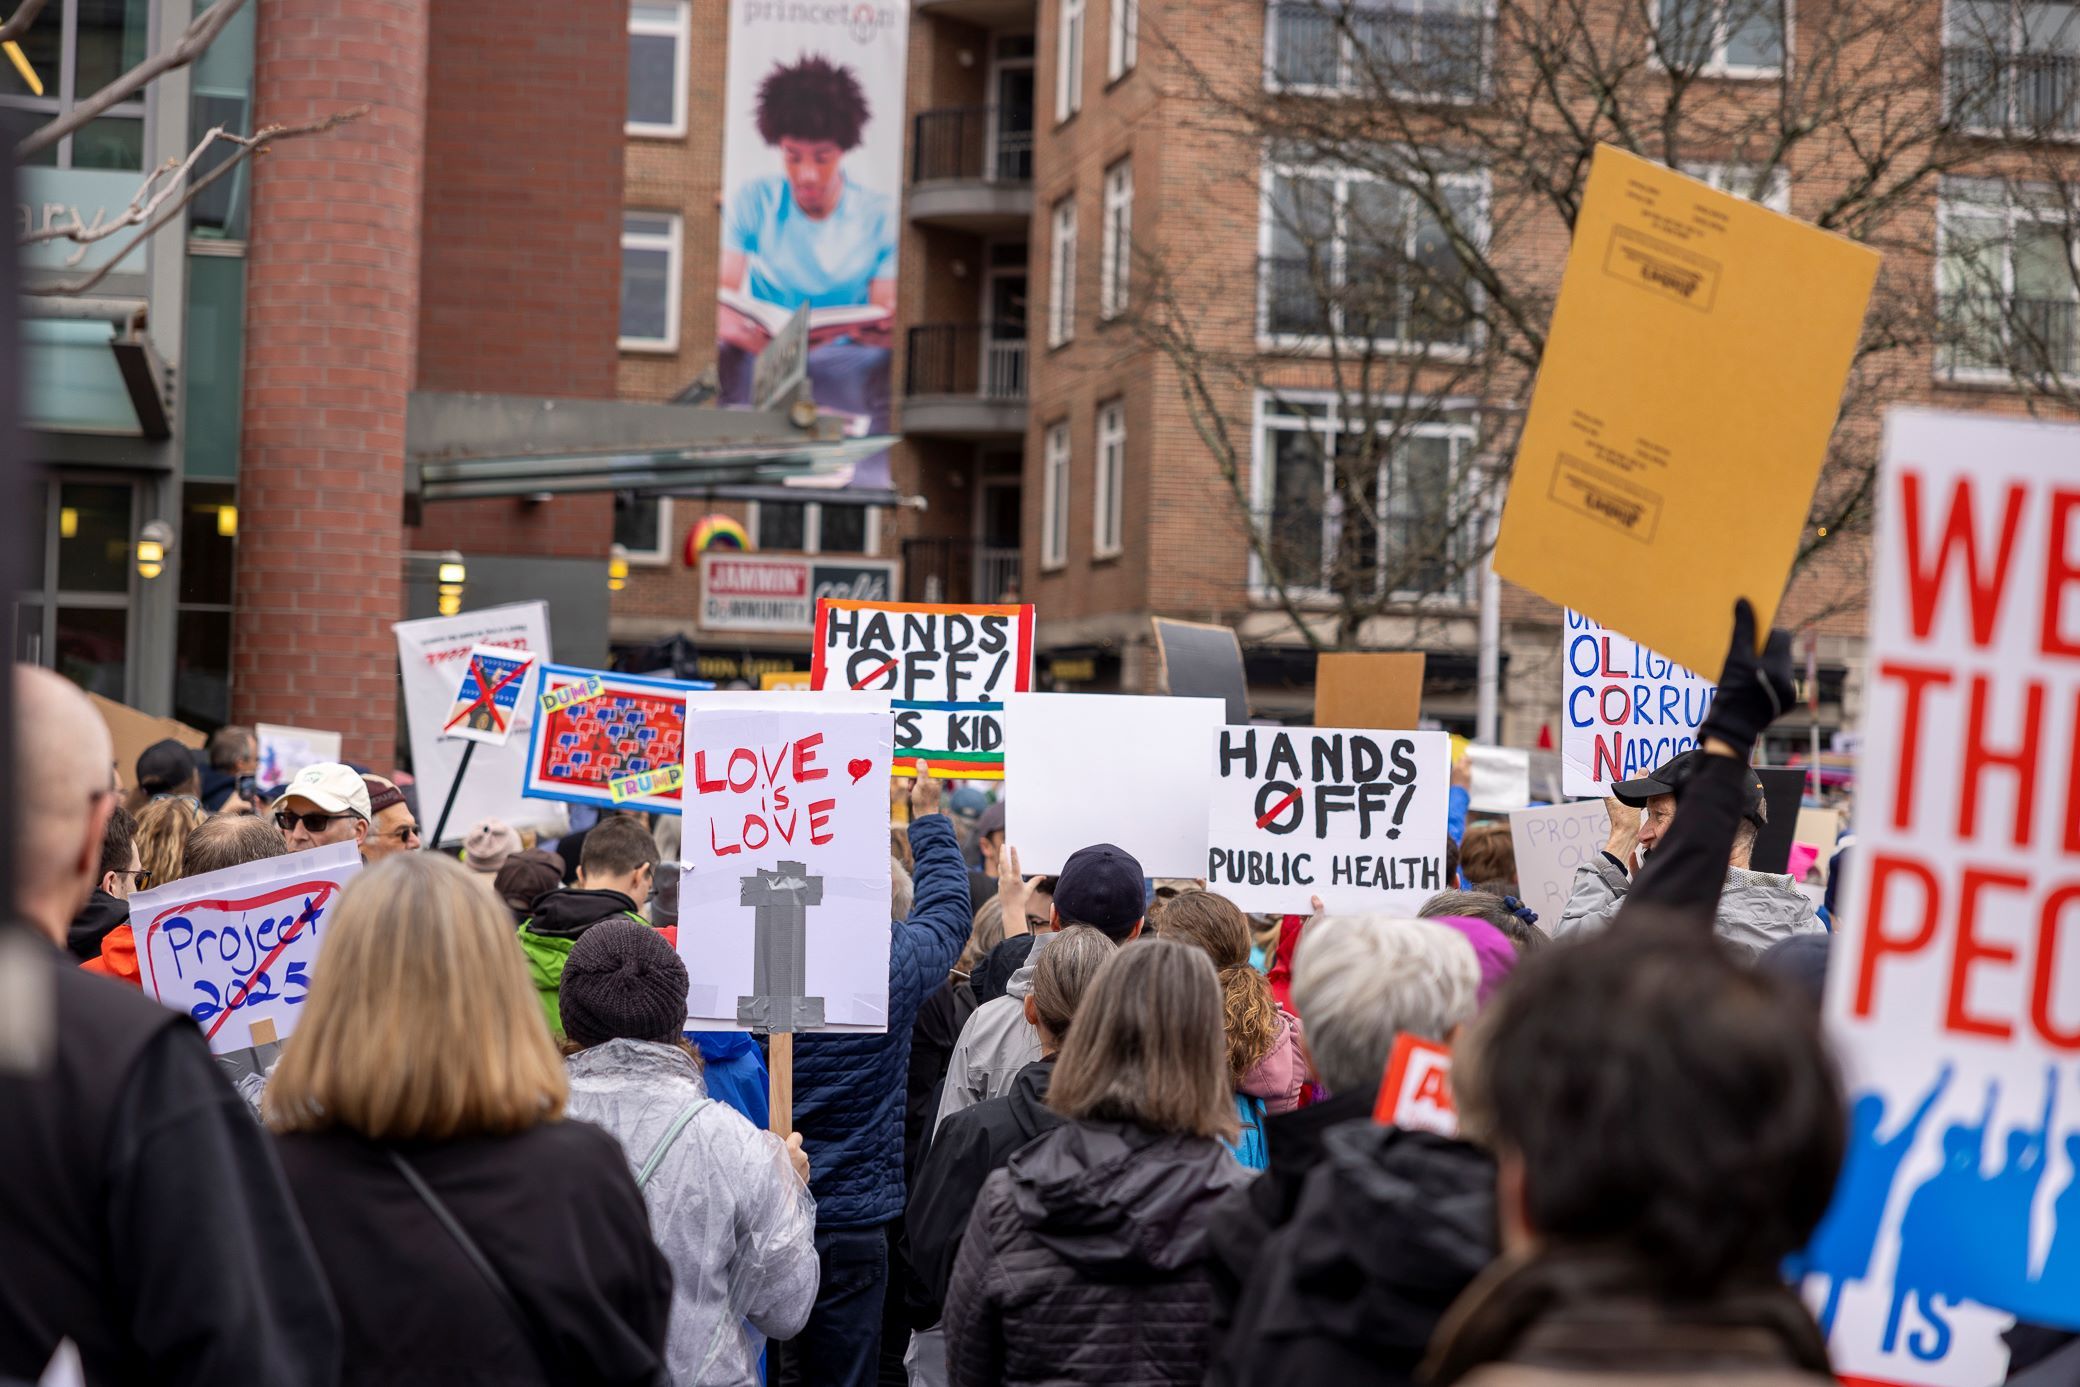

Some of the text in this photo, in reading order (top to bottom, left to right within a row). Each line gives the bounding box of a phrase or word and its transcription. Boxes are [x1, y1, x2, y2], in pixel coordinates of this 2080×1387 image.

[828, 608, 1009, 654] HANDS
[542, 677, 599, 710] DUMP
[846, 649, 1010, 702] OFF!
[1568, 684, 1718, 728] CORRU
[614, 769, 681, 797] TRUMP
[694, 732, 829, 794] LOVE
[1220, 728, 1417, 785] HANDS
[710, 798, 836, 856] LOVE
[1254, 780, 1417, 840] OFF!
[1208, 847, 1440, 890] PUBLIC HEALTH
[162, 896, 325, 980] Project
[191, 962, 313, 1023] 2025
